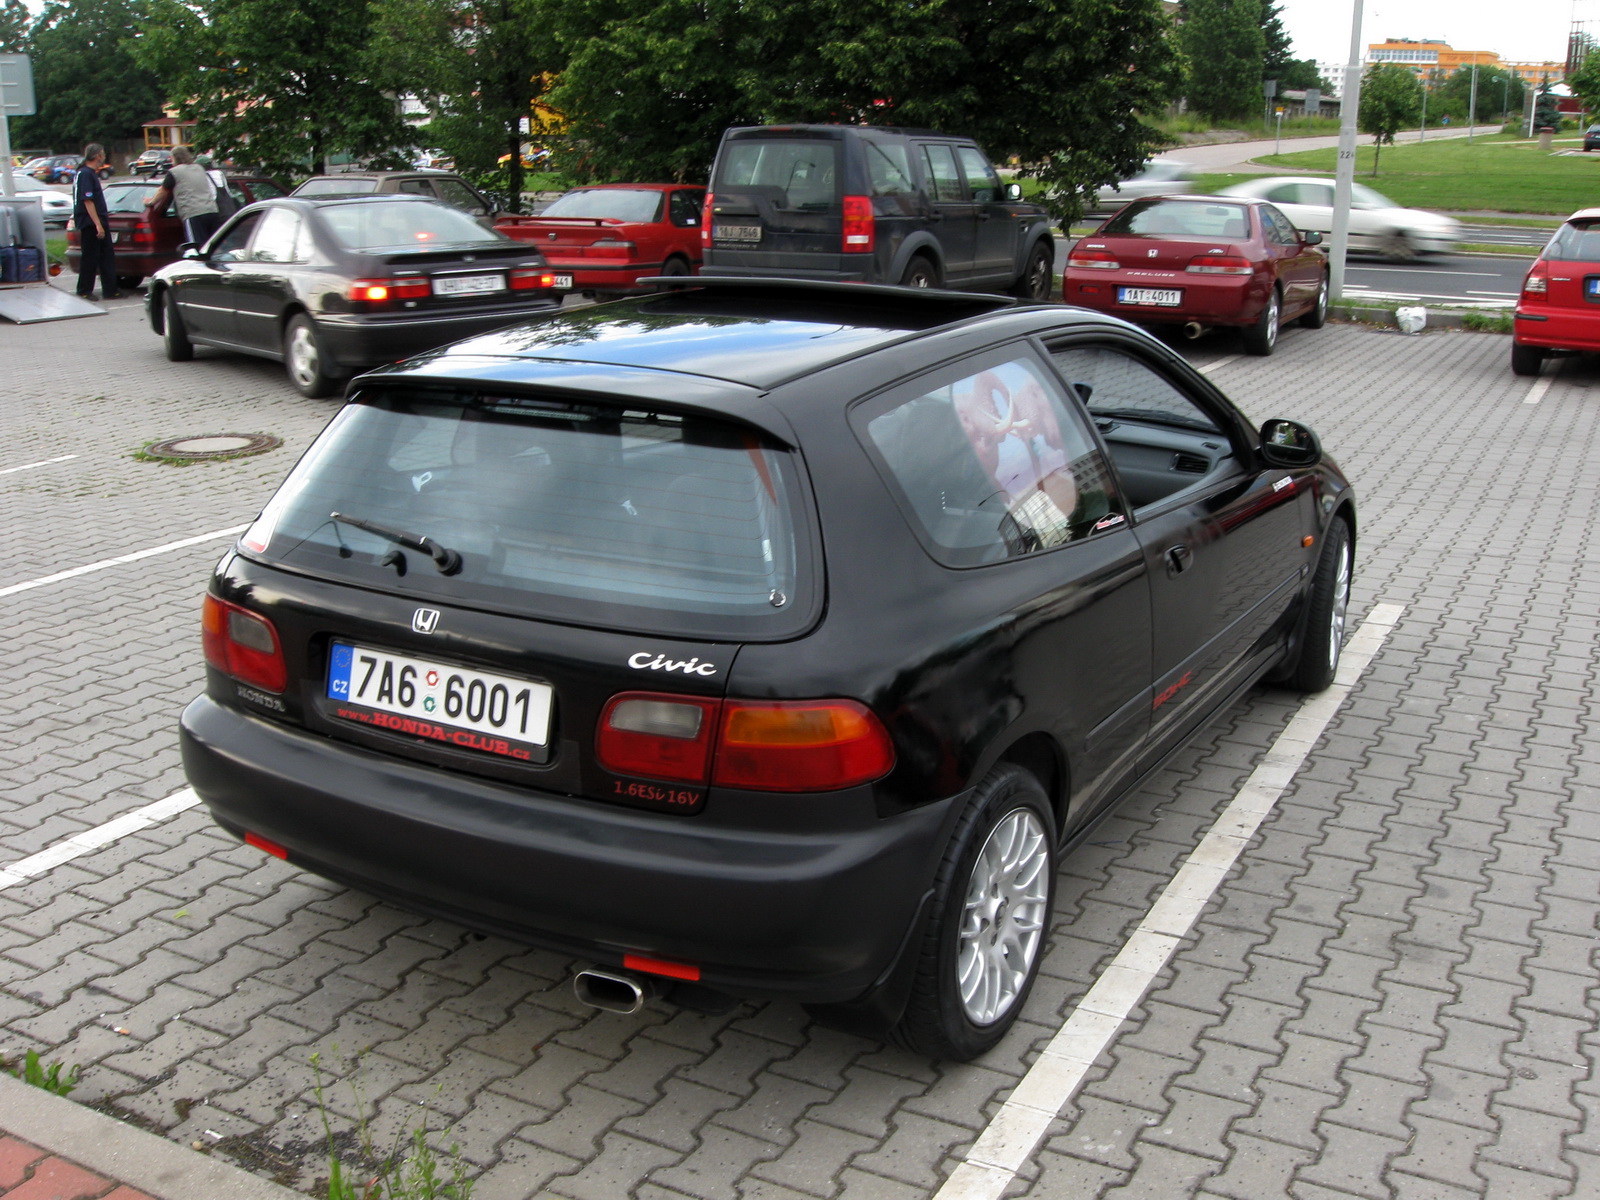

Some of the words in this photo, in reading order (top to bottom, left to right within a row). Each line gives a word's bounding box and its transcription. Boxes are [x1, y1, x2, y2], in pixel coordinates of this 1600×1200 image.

[1127, 289, 1145, 301] 1AT
[1152, 290, 1176, 302] 4011
[628, 652, 717, 676] Civic
[332, 679, 348, 694] CZ
[356, 655, 418, 708] 7A6
[444, 674, 531, 734] 6001
[237, 686, 286, 712] HONDA
[337, 707, 531, 761] www.HONDA-CLUB.cz
[667, 790, 700, 806] 16V
